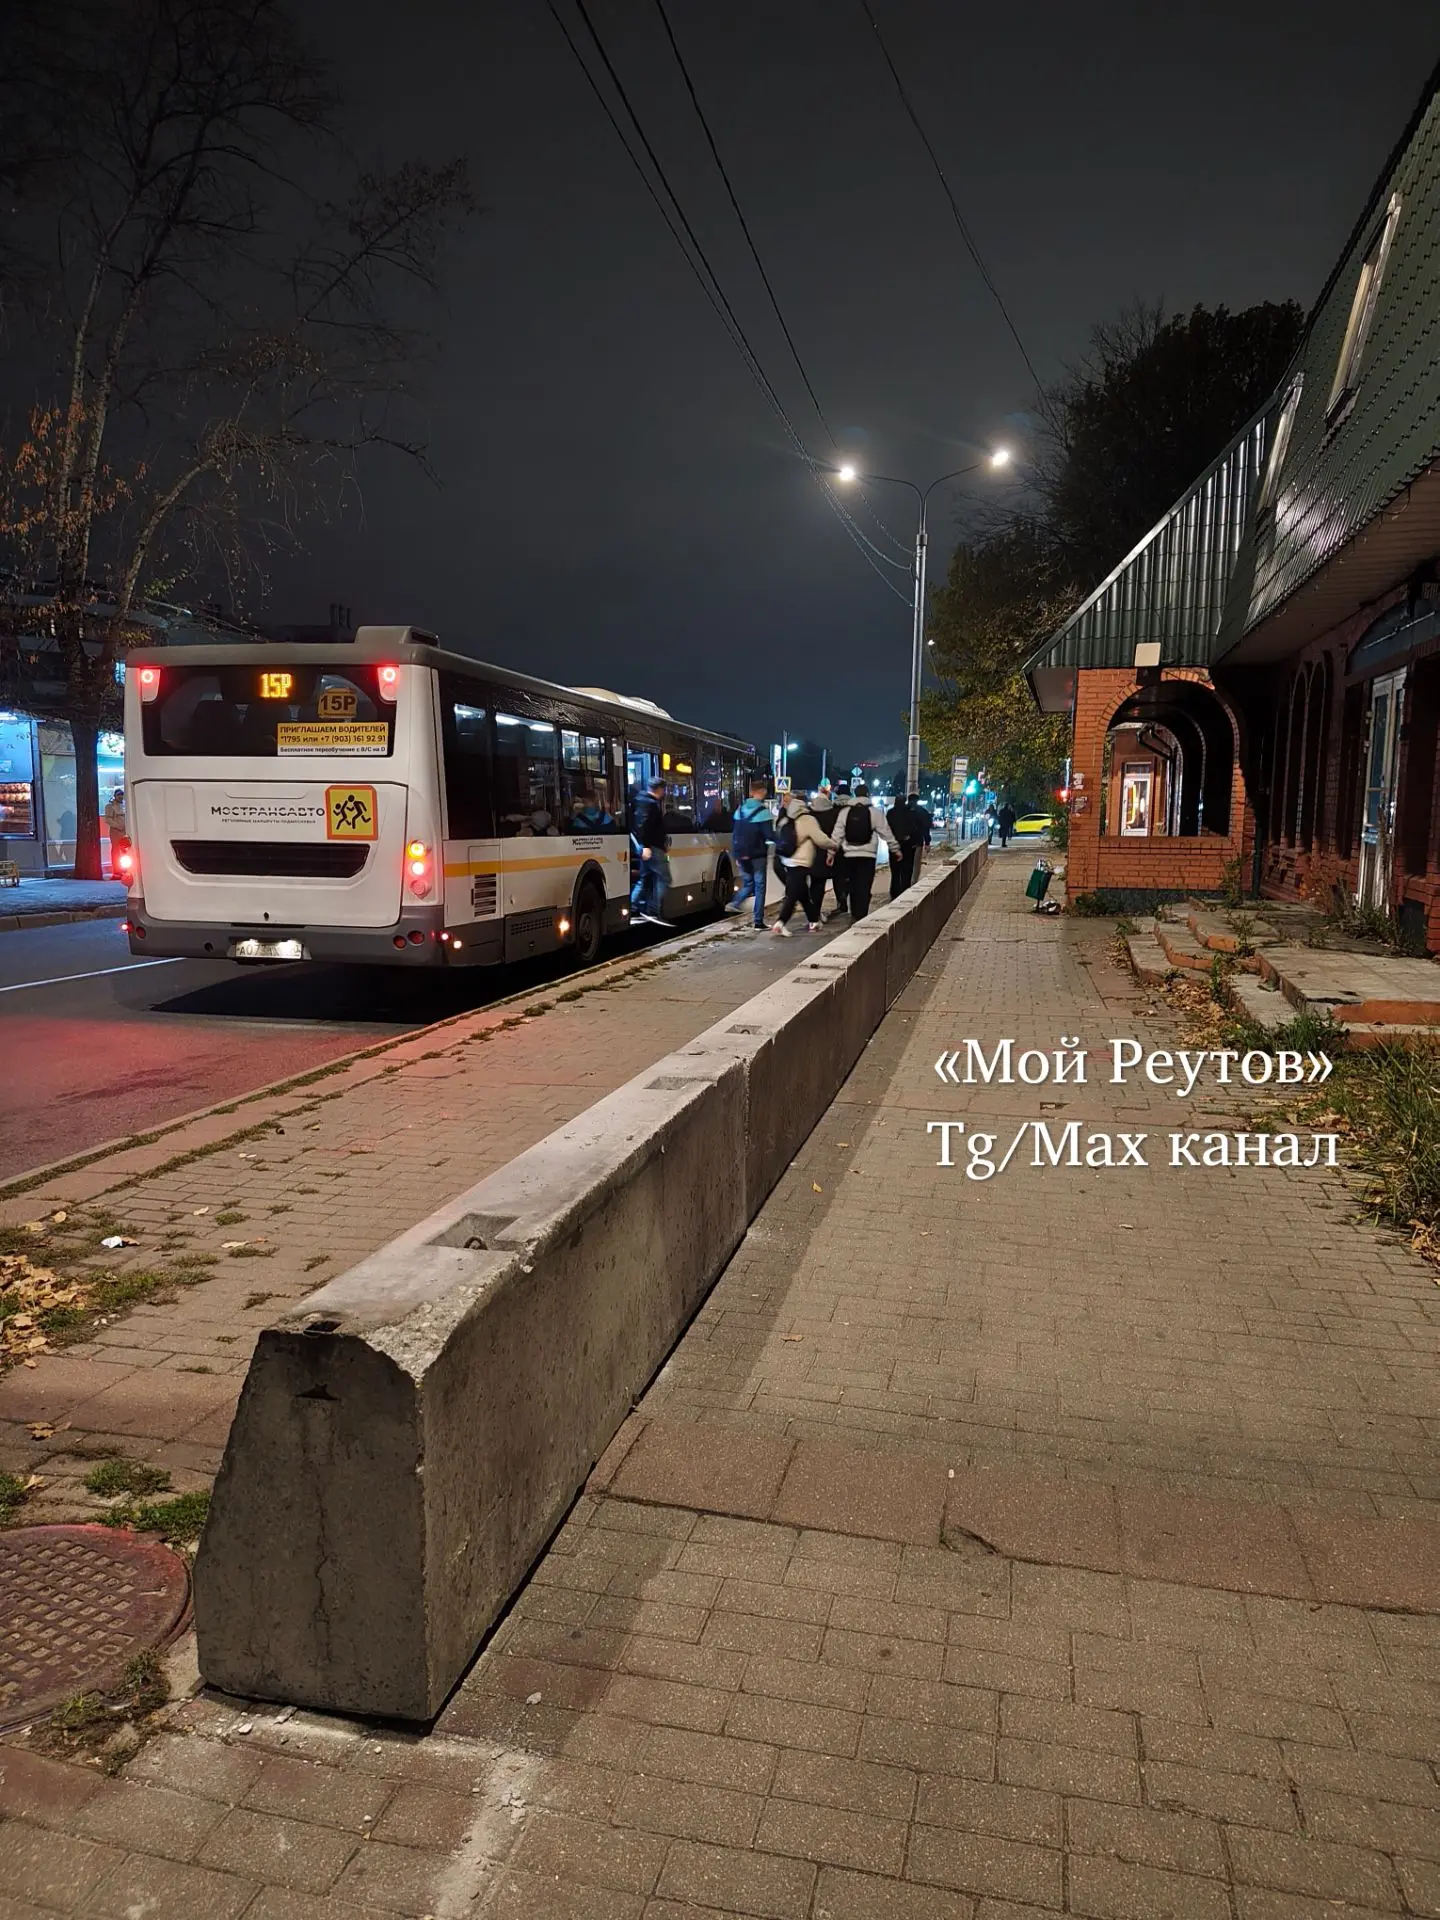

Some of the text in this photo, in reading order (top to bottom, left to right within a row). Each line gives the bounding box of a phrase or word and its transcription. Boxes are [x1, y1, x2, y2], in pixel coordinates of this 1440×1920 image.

[338, 724, 386, 733] ВОДИТЕЛЕЙ
[320, 735, 330, 743] +7
[331, 735, 351, 744] (903)
[353, 735, 364, 743] 161
[366, 735, 376, 743] 92
[377, 735, 386, 743] 91
[211, 806, 325, 817] МОСТРАНСАВТО
